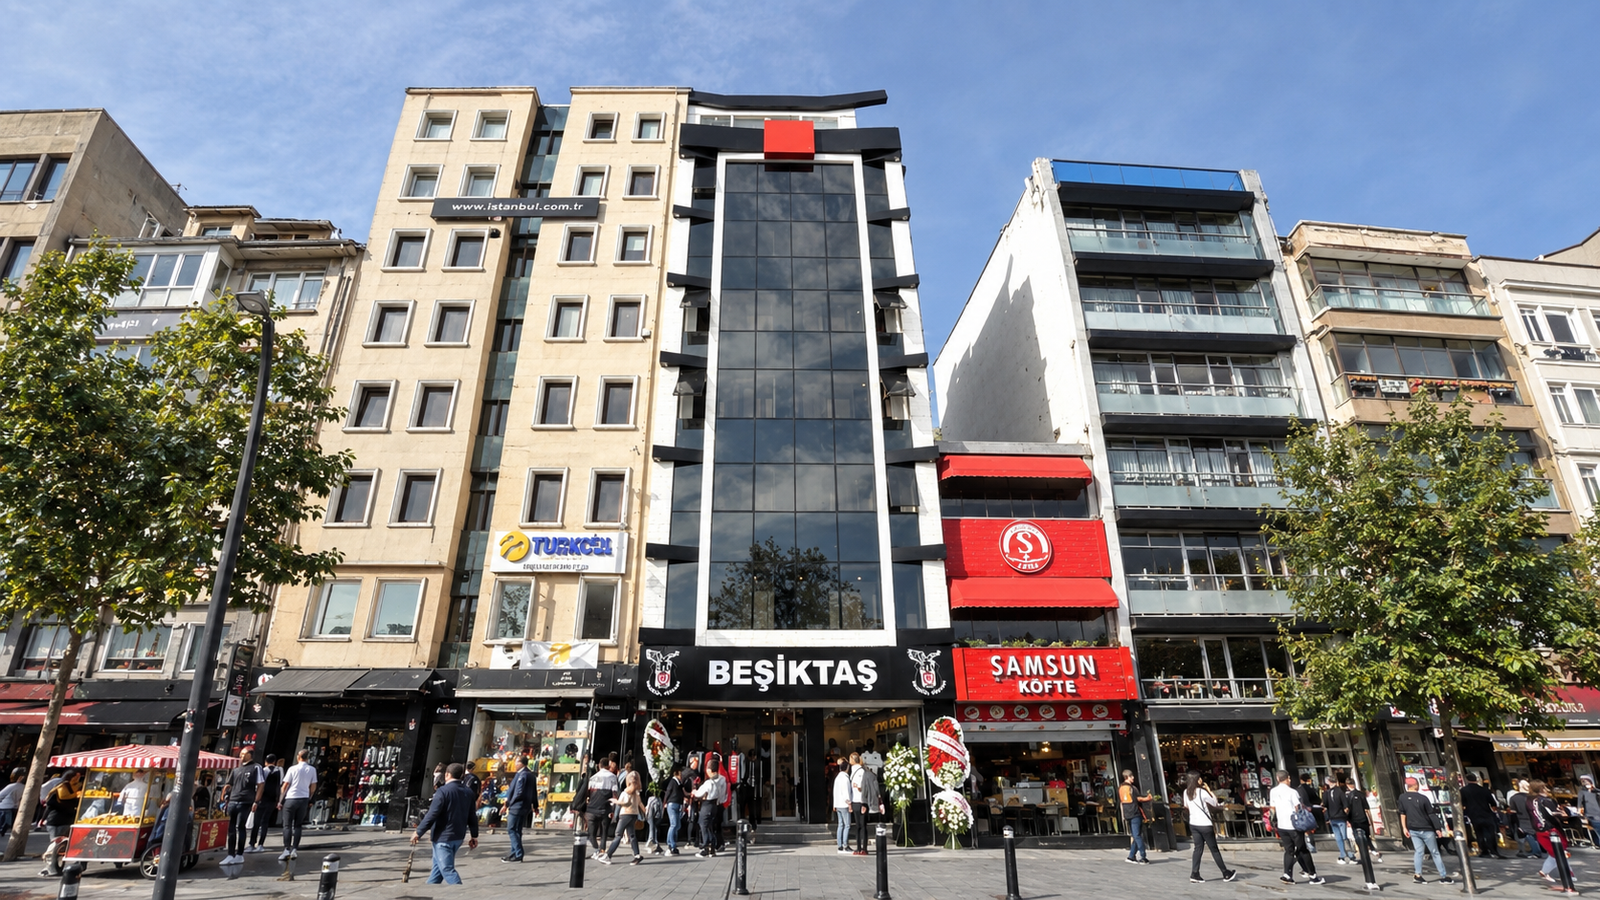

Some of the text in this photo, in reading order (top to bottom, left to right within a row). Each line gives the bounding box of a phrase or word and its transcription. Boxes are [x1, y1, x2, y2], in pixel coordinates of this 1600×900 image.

[452, 202, 583, 212] www.istanbul.com.tr
[708, 654, 878, 692] BEŞİKTAŞ
[990, 654, 1096, 676] SAMSUN
[1018, 678, 1077, 694] KÖFTE
